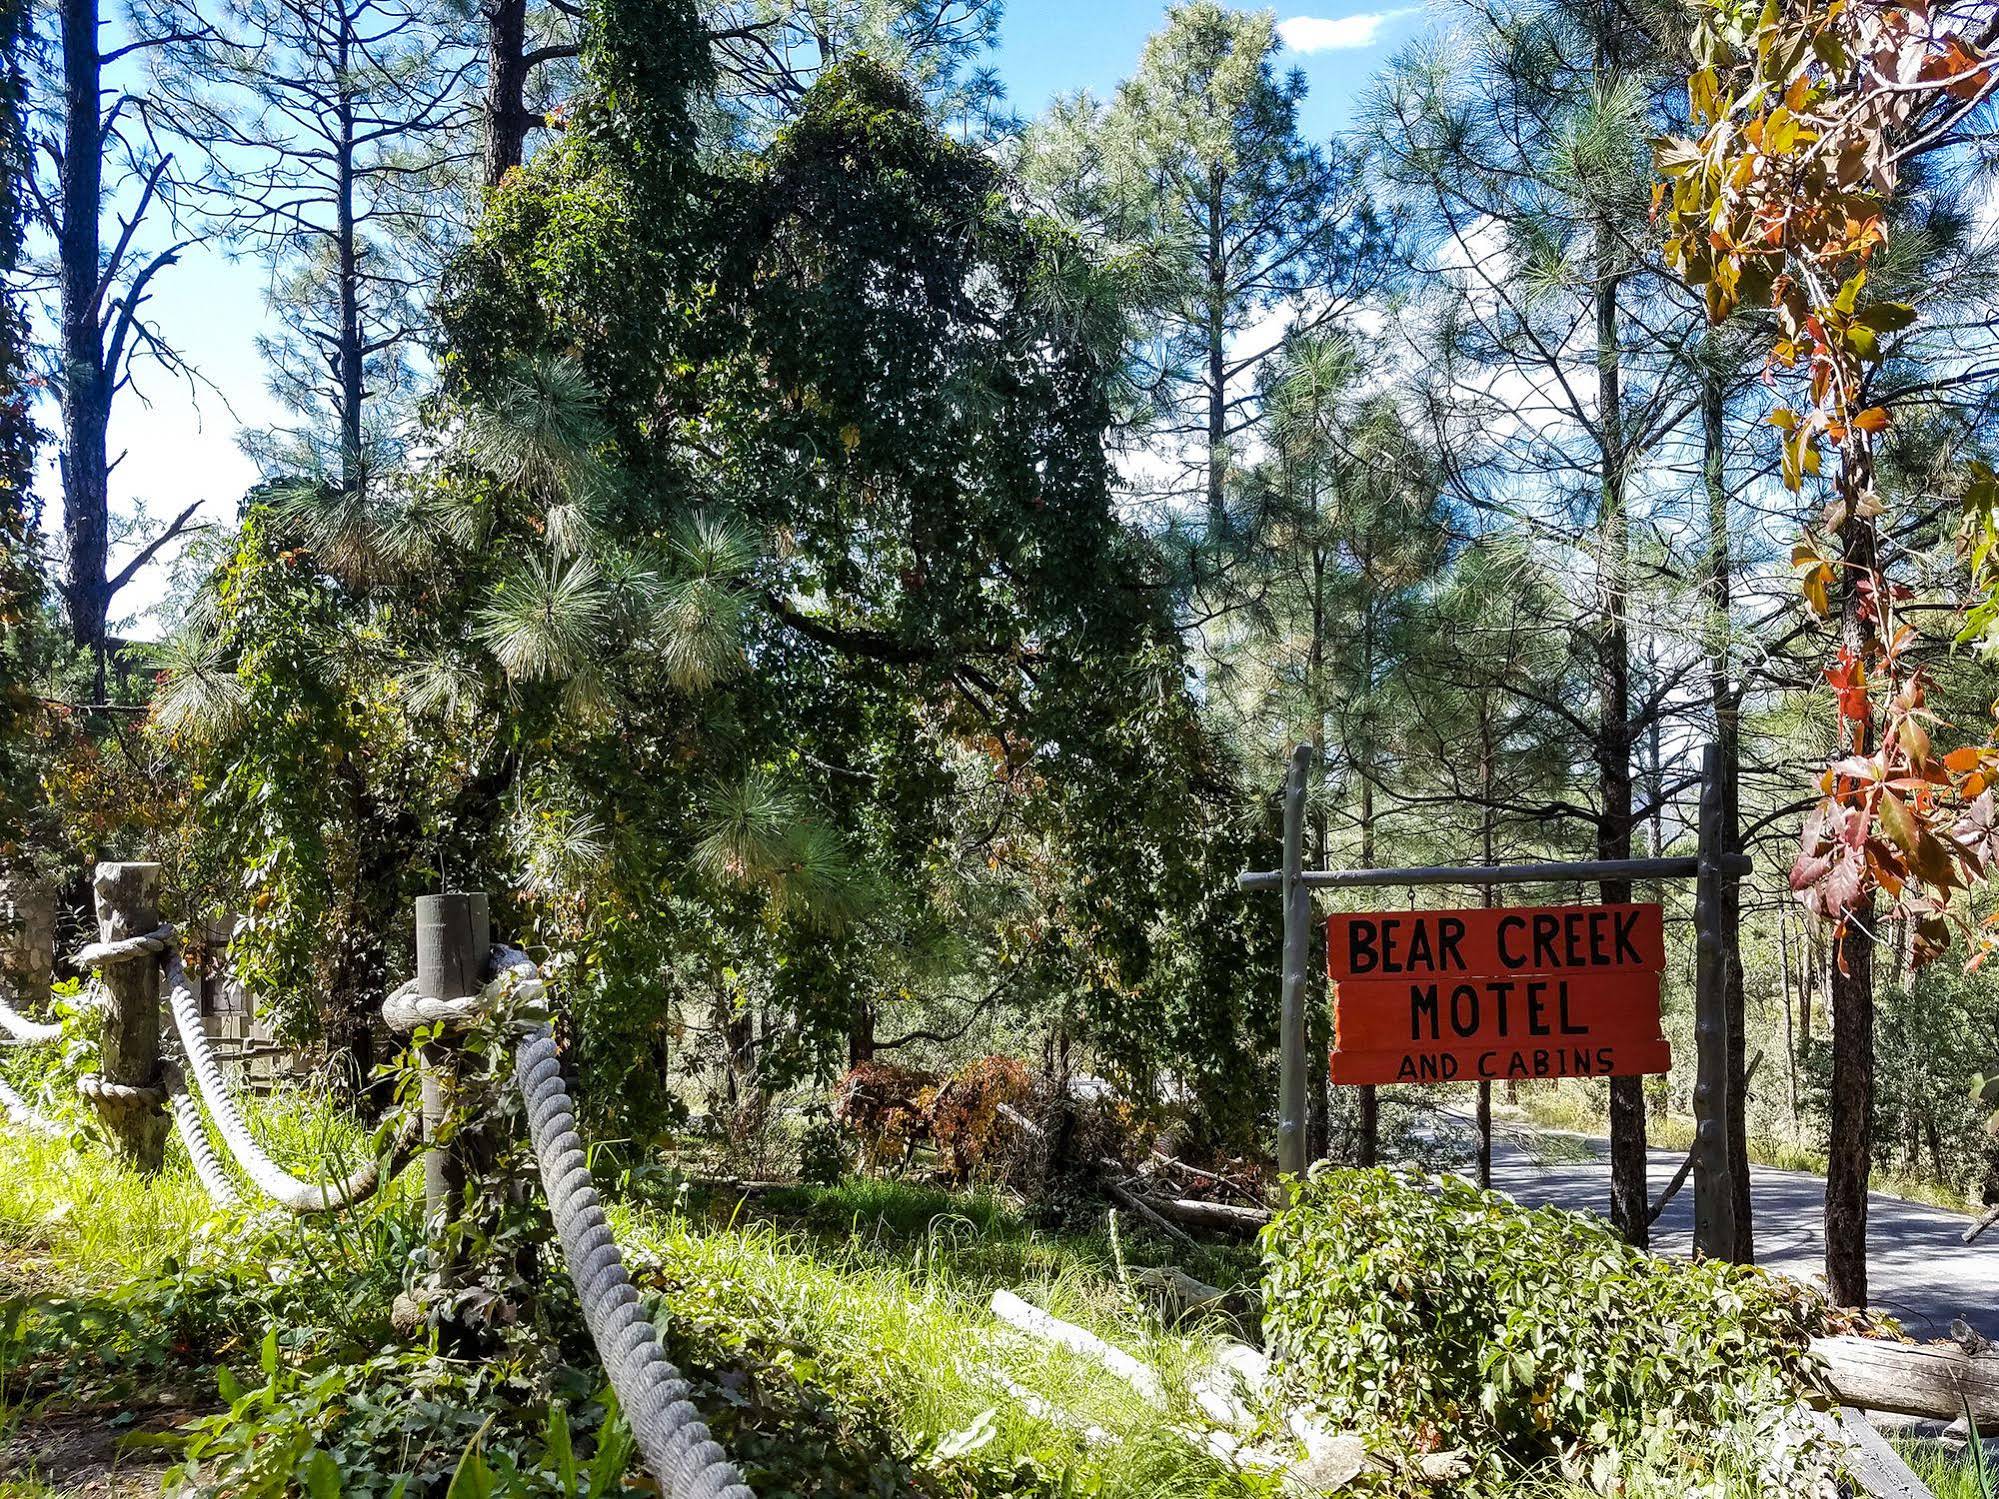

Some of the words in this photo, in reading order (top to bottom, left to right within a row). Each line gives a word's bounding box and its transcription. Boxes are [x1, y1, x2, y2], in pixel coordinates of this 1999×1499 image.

[1349, 917, 1468, 975] BEAR
[1496, 910, 1644, 969] CREEK
[1410, 980, 1590, 1041] MOTEL
[1396, 1053, 1458, 1081] AND
[1478, 1047, 1615, 1079] CABINS
